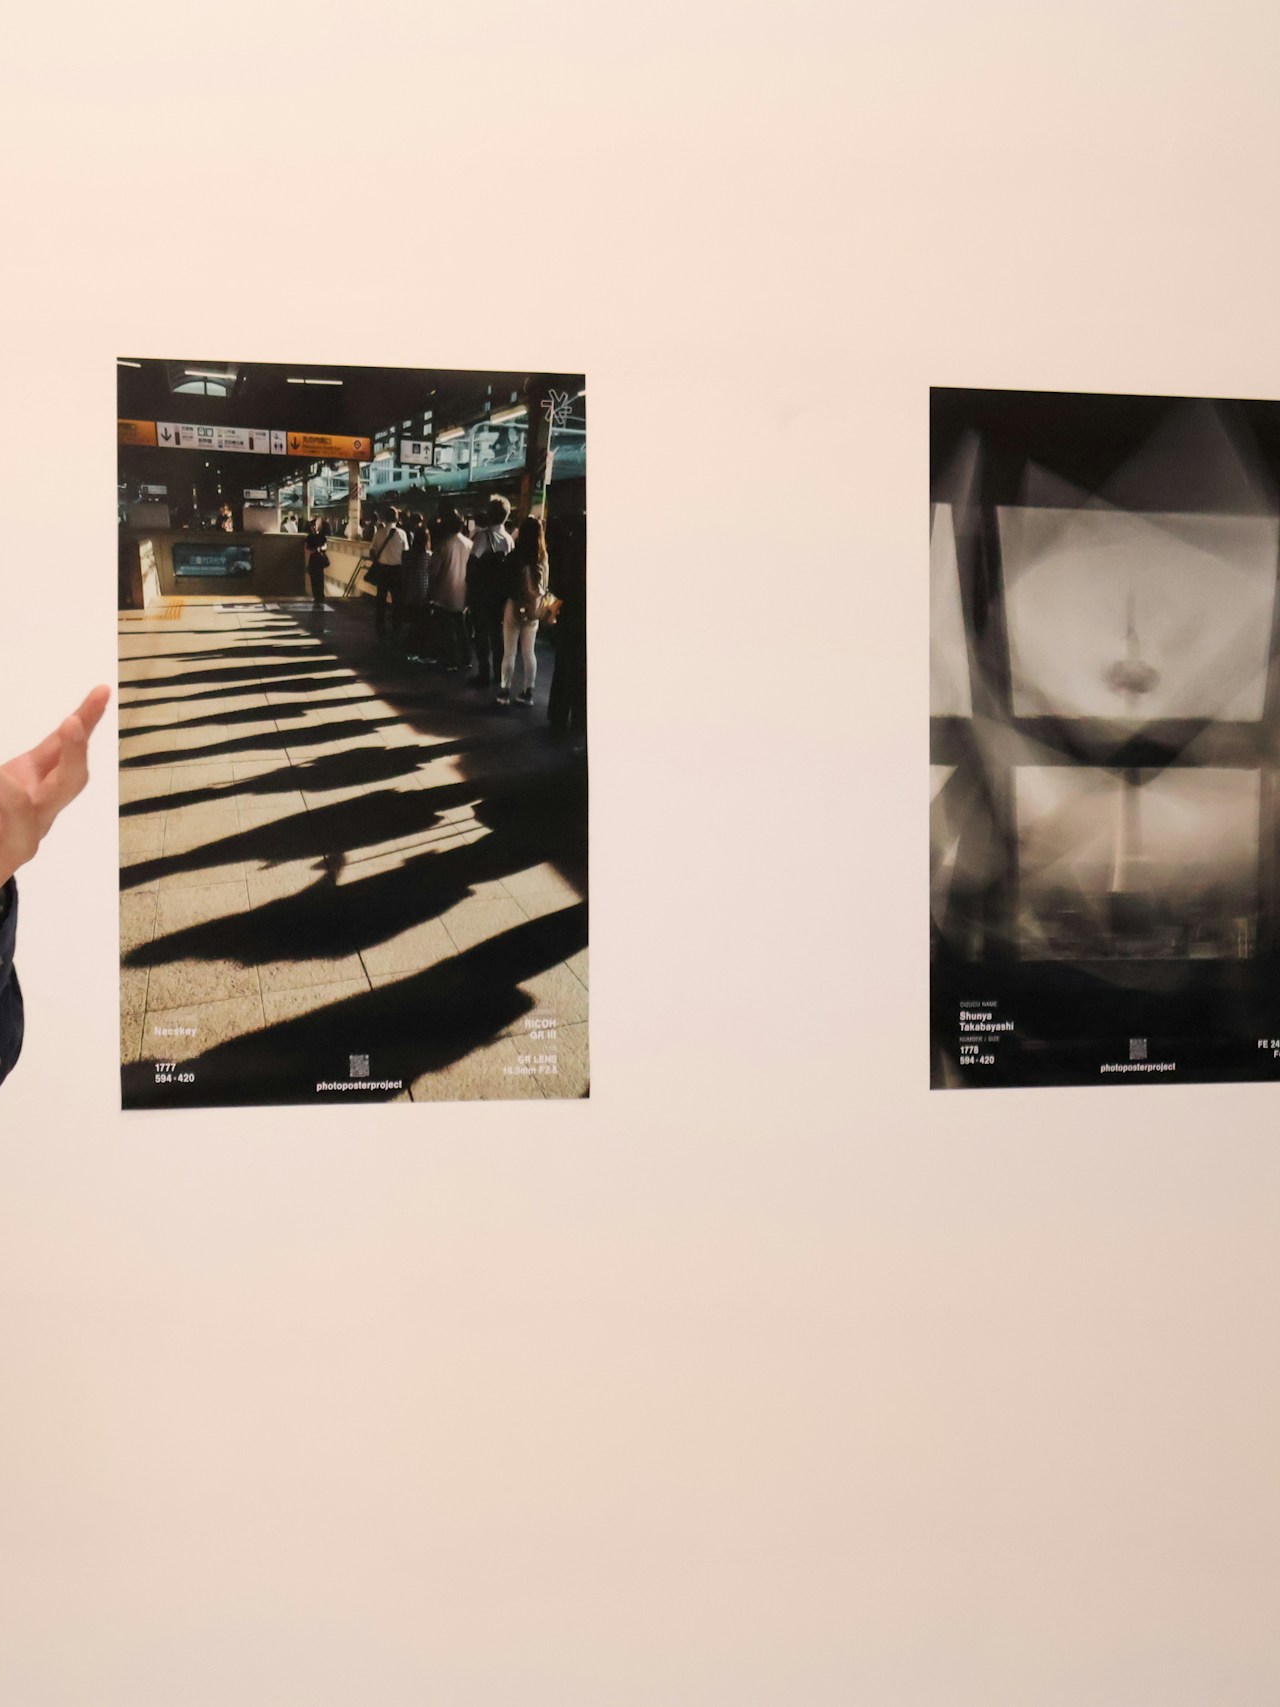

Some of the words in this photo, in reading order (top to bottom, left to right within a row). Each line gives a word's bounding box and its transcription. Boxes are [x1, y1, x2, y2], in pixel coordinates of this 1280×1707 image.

[960, 1011, 992, 1021] Shunya
[525, 1019, 556, 1029] RICOH
[959, 1021, 1014, 1033] Takabayashi
[530, 1030, 544, 1040] GR
[1258, 1040, 1269, 1049] FE
[960, 1045, 979, 1055] 1778
[534, 1054, 557, 1064] LENS
[155, 1063, 176, 1072] 1777
[1100, 1062, 1176, 1073] photoposterproject
[316, 1080, 402, 1092] photoposterproject
